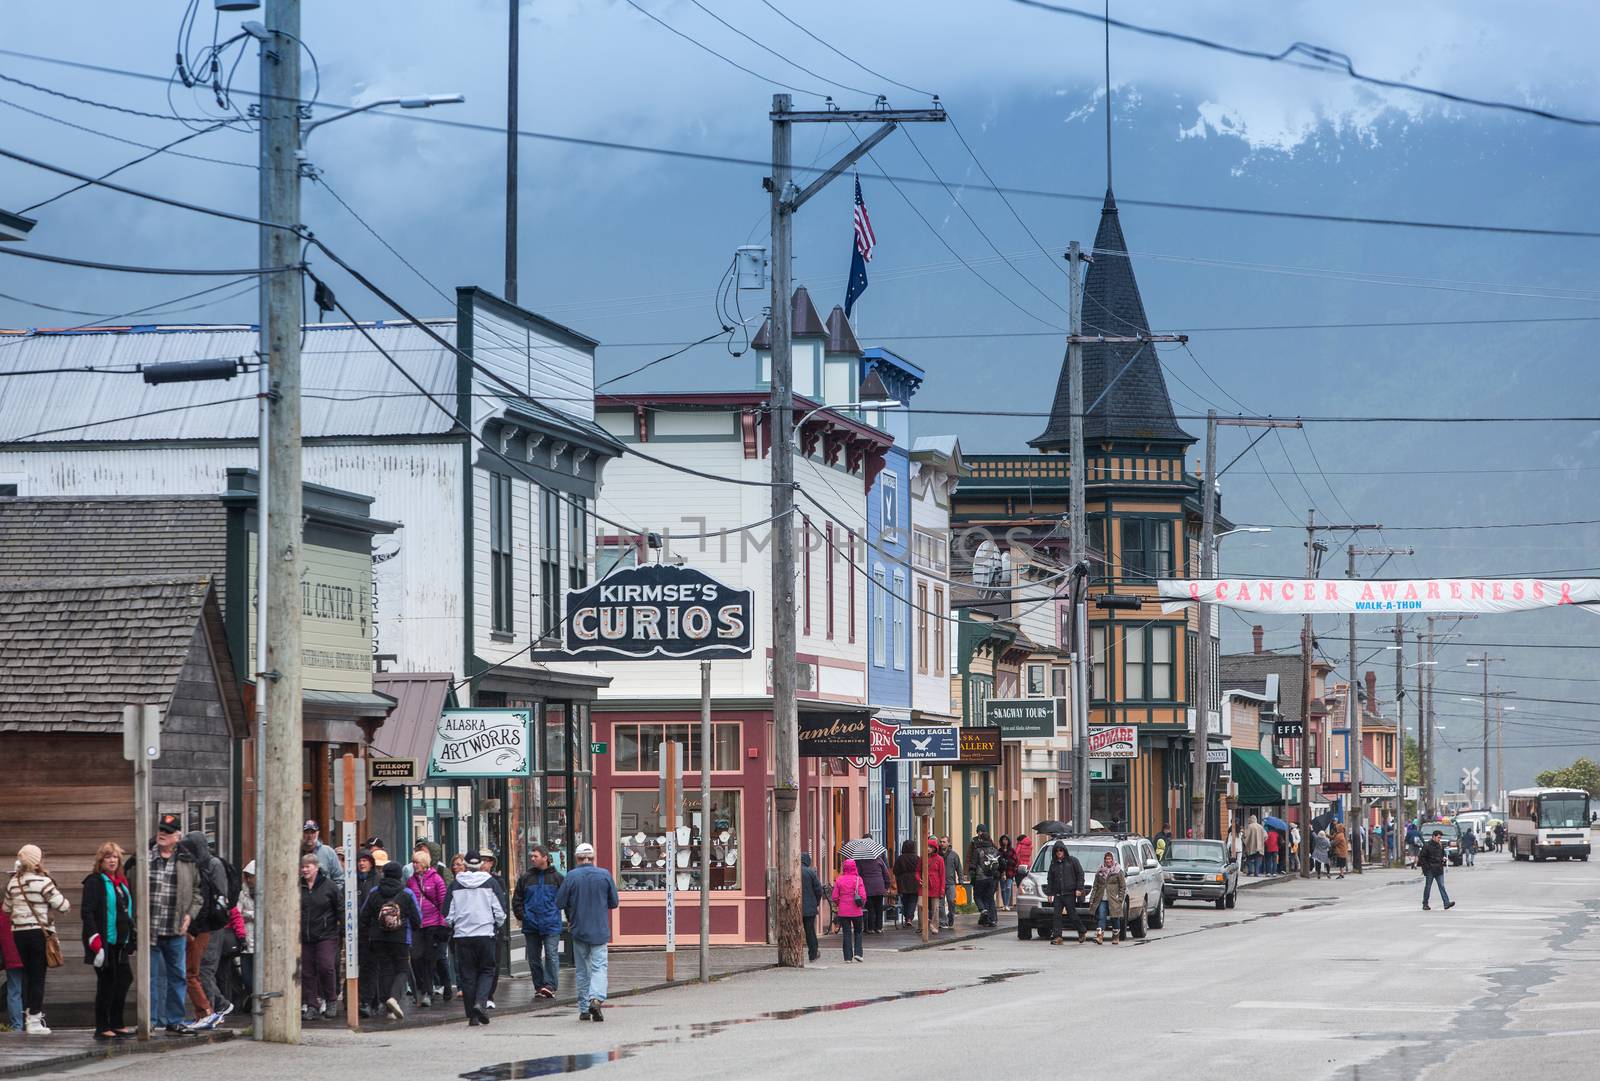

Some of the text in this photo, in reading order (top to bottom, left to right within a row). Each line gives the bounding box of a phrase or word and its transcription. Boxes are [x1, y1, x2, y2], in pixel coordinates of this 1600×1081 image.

[600, 584, 718, 602] KIRMSE'S
[1216, 581, 1544, 601] CANCER AWARENESS
[315, 583, 354, 620] CENTER
[1356, 600, 1422, 610] WALK-A-THON
[573, 605, 744, 641] CURIOS
[993, 707, 1047, 719] SKAGWAY TOURS
[445, 719, 486, 731] ALASKA
[798, 718, 866, 741] ambros
[1278, 725, 1304, 734] EFFY
[440, 728, 521, 760] ARTWORKS
[960, 742, 994, 751] ALLERY
